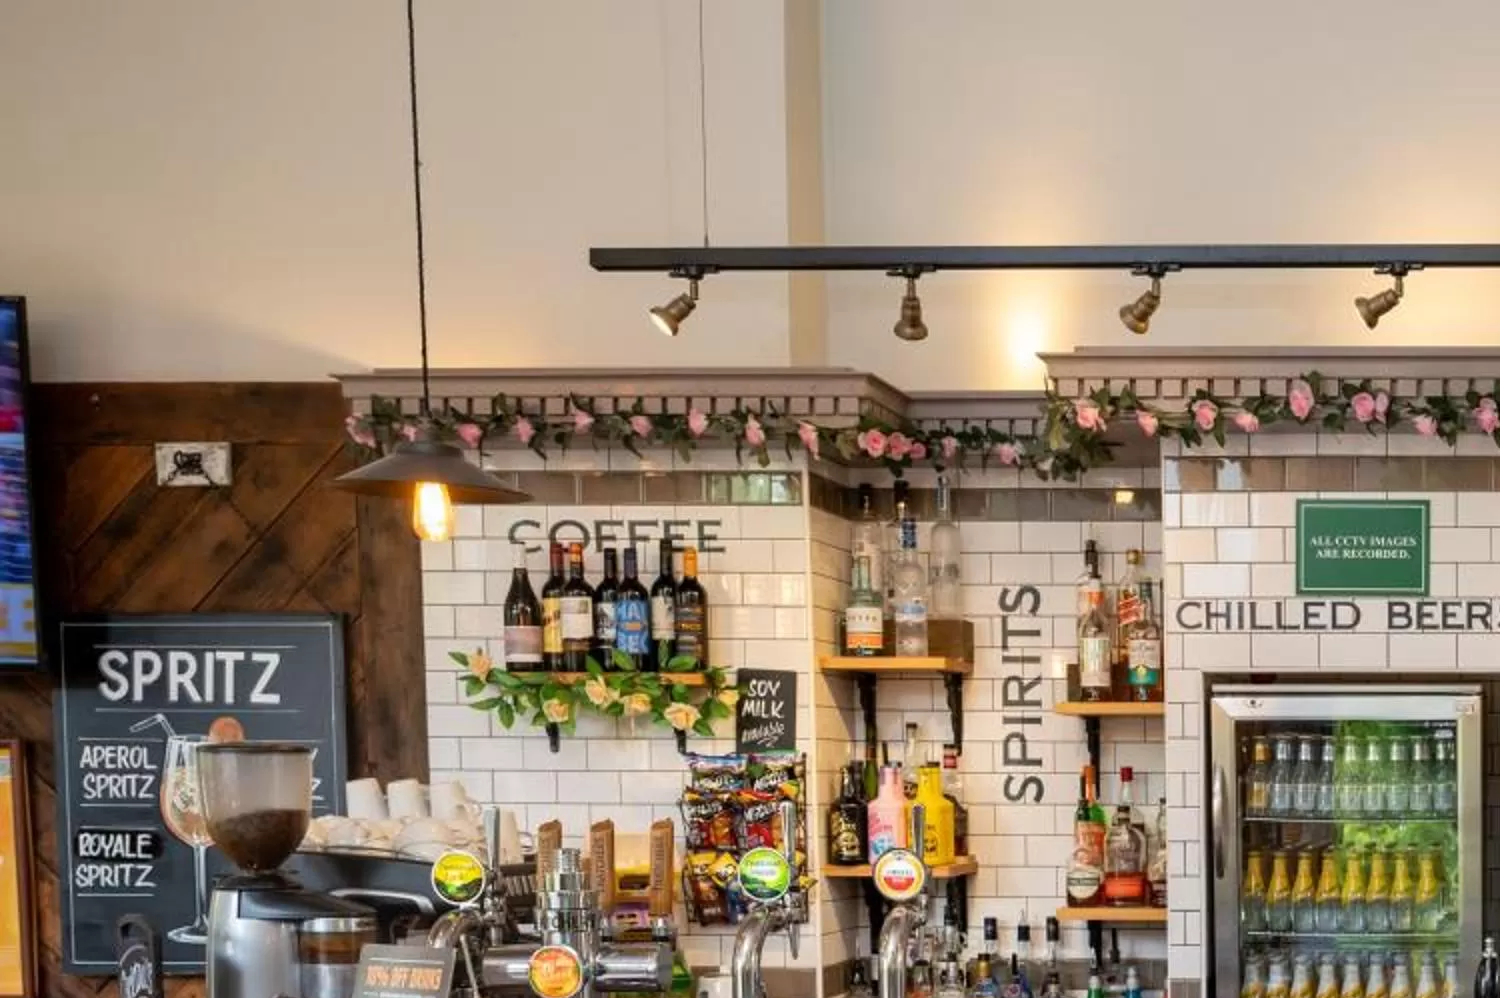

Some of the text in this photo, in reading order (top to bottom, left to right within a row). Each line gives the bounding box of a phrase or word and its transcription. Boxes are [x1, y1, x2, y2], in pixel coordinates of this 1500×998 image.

[508, 519, 726, 553] COFFEE
[1311, 535, 1417, 547] ALL CCTV IMAGES
[1315, 548, 1341, 559] ARE
[1176, 600, 1361, 631] CHILLED
[99, 650, 281, 705] SPRITZ
[747, 678, 781, 697] SOY
[999, 584, 1045, 804] SPIRITS
[741, 699, 785, 719] MILK
[80, 745, 157, 770] APEROL
[83, 773, 155, 799] SPRITZ
[78, 832, 153, 860] ROYALE
[75, 863, 156, 888] SPRITZ
